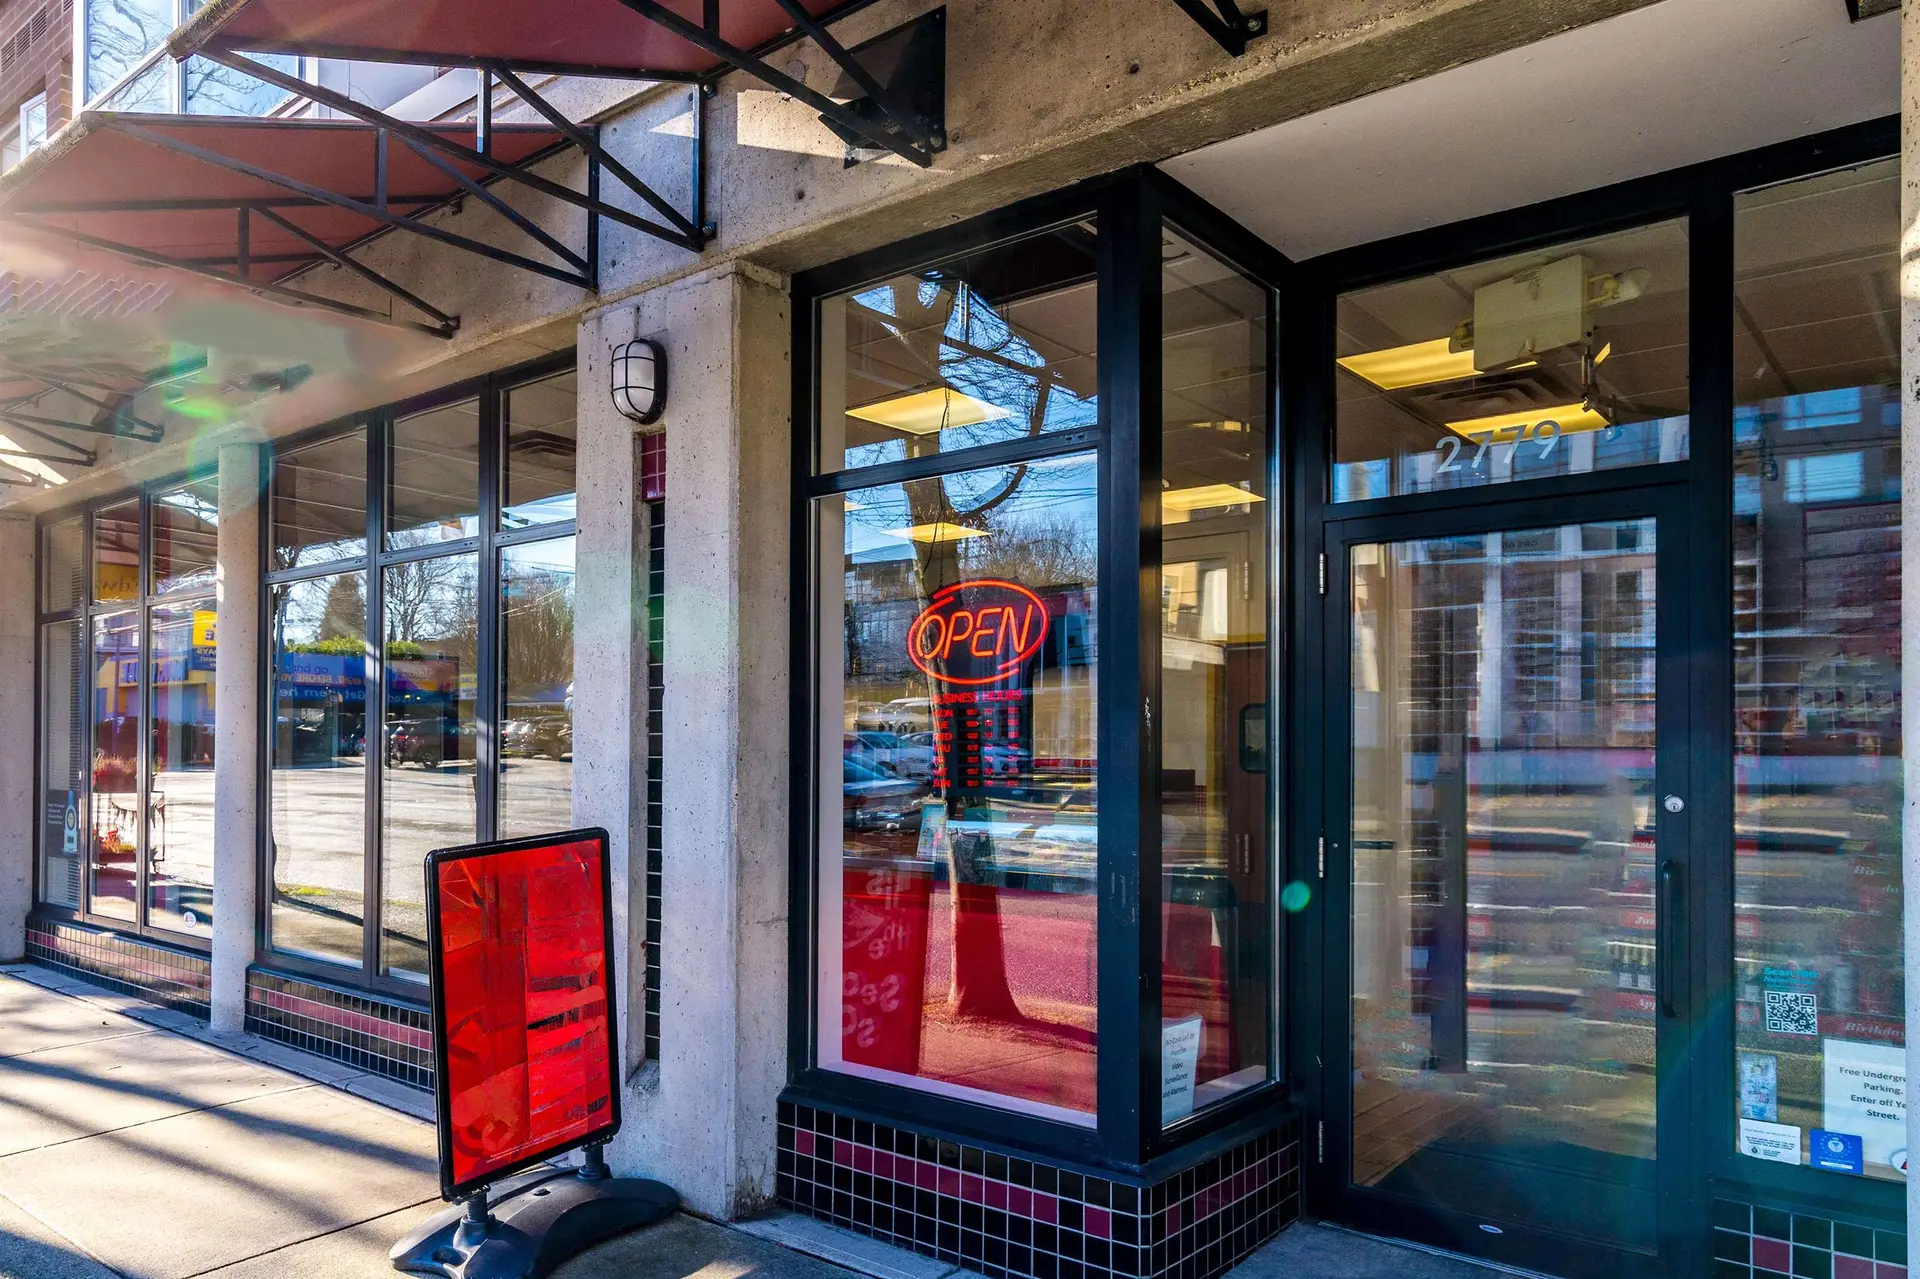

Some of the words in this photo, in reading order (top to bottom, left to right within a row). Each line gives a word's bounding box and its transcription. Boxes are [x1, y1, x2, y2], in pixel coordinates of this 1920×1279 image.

[1435, 419, 1562, 474] 2779
[915, 603, 1033, 660] OPEN
[1171, 1061, 1184, 1070] Video
[1839, 1065, 1861, 1077] Free
[1863, 1082, 1904, 1096] Parking.
[1850, 1094, 1878, 1105] Enter
[1879, 1097, 1894, 1107] off
[1866, 1109, 1901, 1121] Street.
